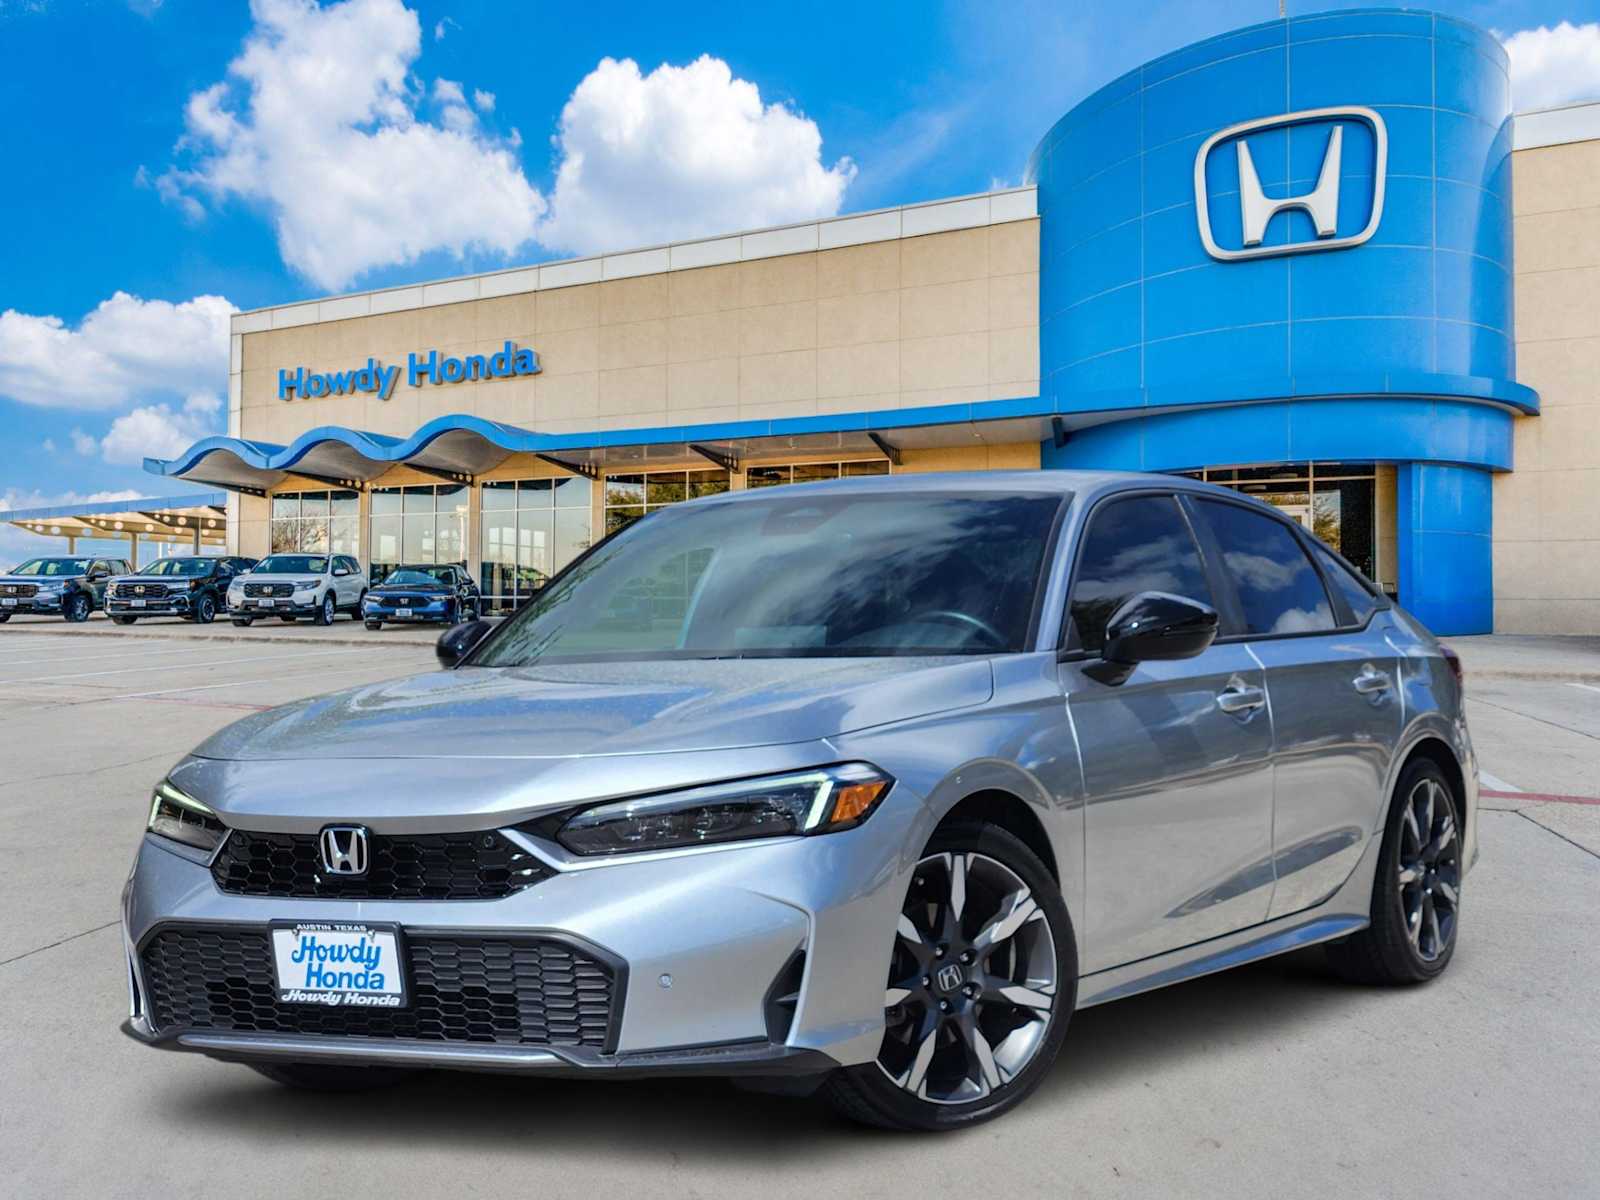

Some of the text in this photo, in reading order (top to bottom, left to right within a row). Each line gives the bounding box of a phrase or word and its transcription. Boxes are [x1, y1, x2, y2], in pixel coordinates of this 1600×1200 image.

[278, 340, 541, 400] Howdy Honda
[296, 923, 367, 932] AUSTIN TEXAS
[291, 935, 382, 970] Howdy
[305, 962, 385, 990] Honda
[281, 989, 401, 1006] Howdy Honda
